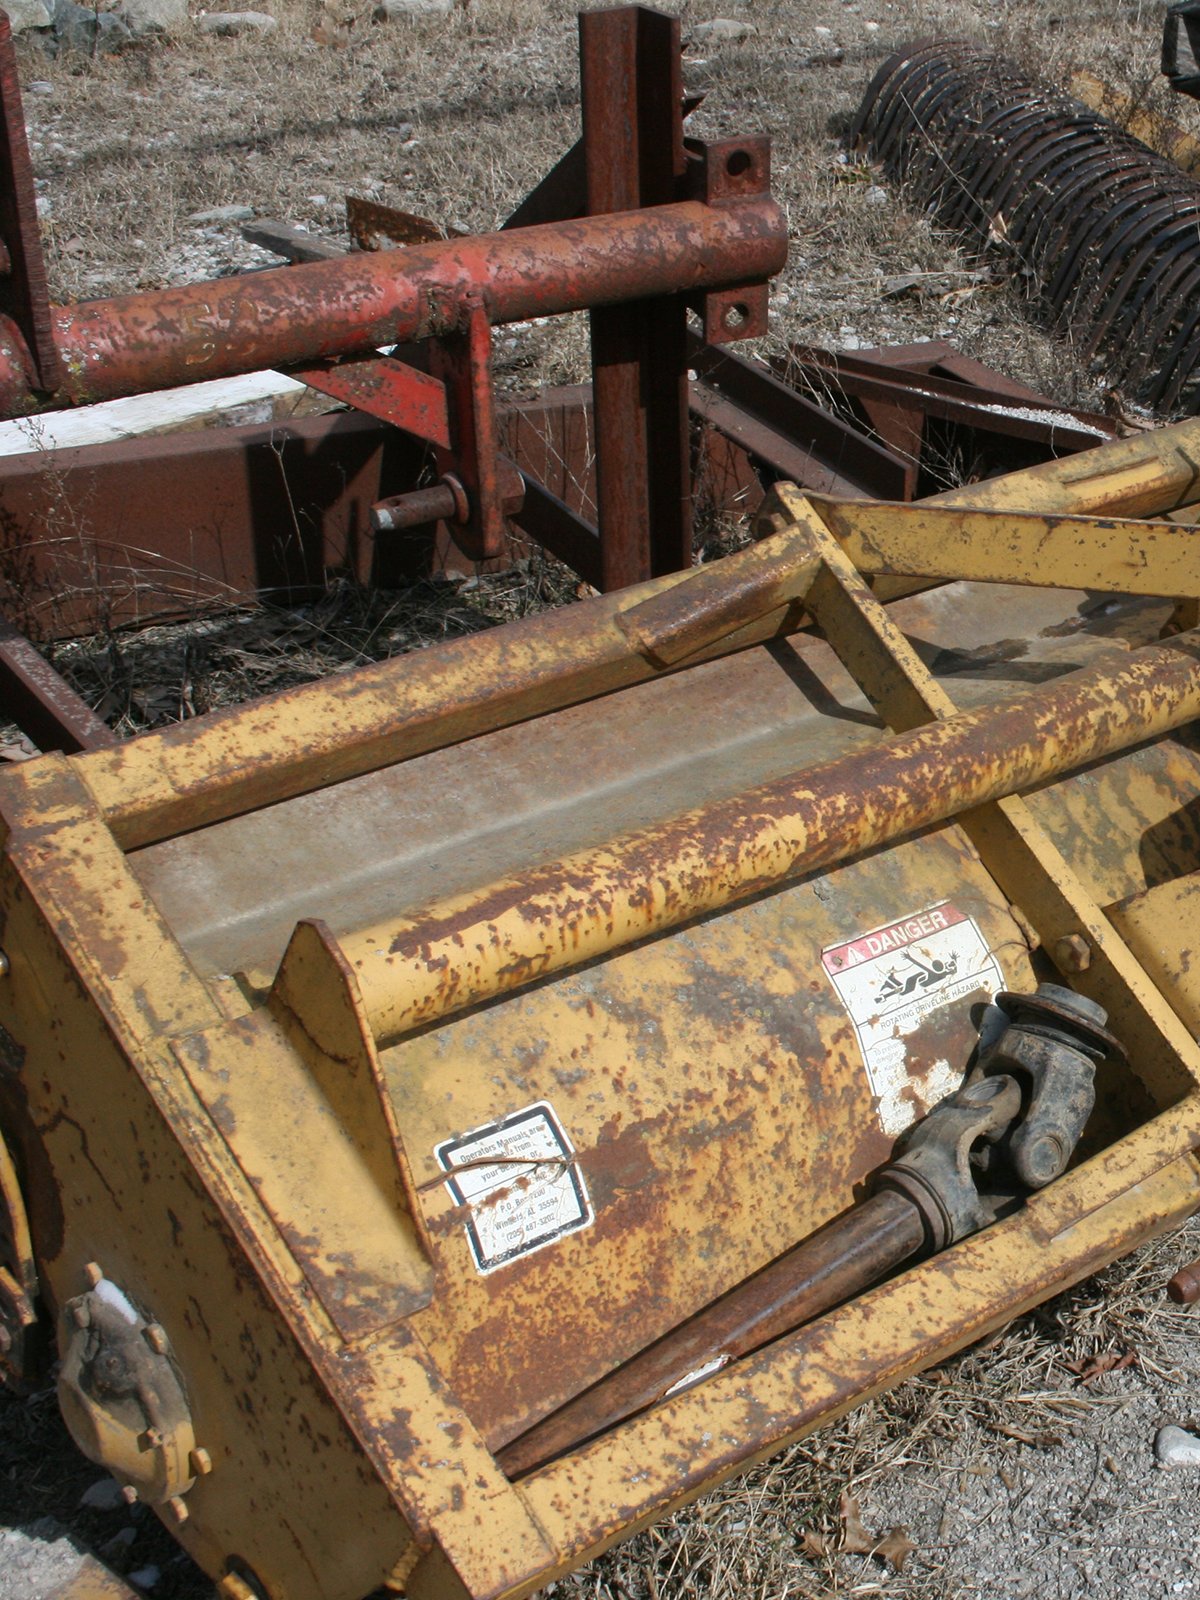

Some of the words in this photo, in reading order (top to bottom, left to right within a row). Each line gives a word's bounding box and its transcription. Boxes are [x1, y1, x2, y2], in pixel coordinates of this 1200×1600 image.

[865, 910, 948, 957] DANGER
[880, 1009, 915, 1030] ROTATING
[915, 993, 951, 1015] DRIVELINE
[952, 980, 980, 997] HAZARD
[460, 1144, 497, 1164] Operators
[496, 1132, 528, 1148] Manuals
[528, 1126, 541, 1138] are
[513, 1141, 532, 1153] from
[481, 1168, 499, 1182] your
[538, 1197, 559, 1211] 35594
[525, 1213, 556, 1232] 487-3202
